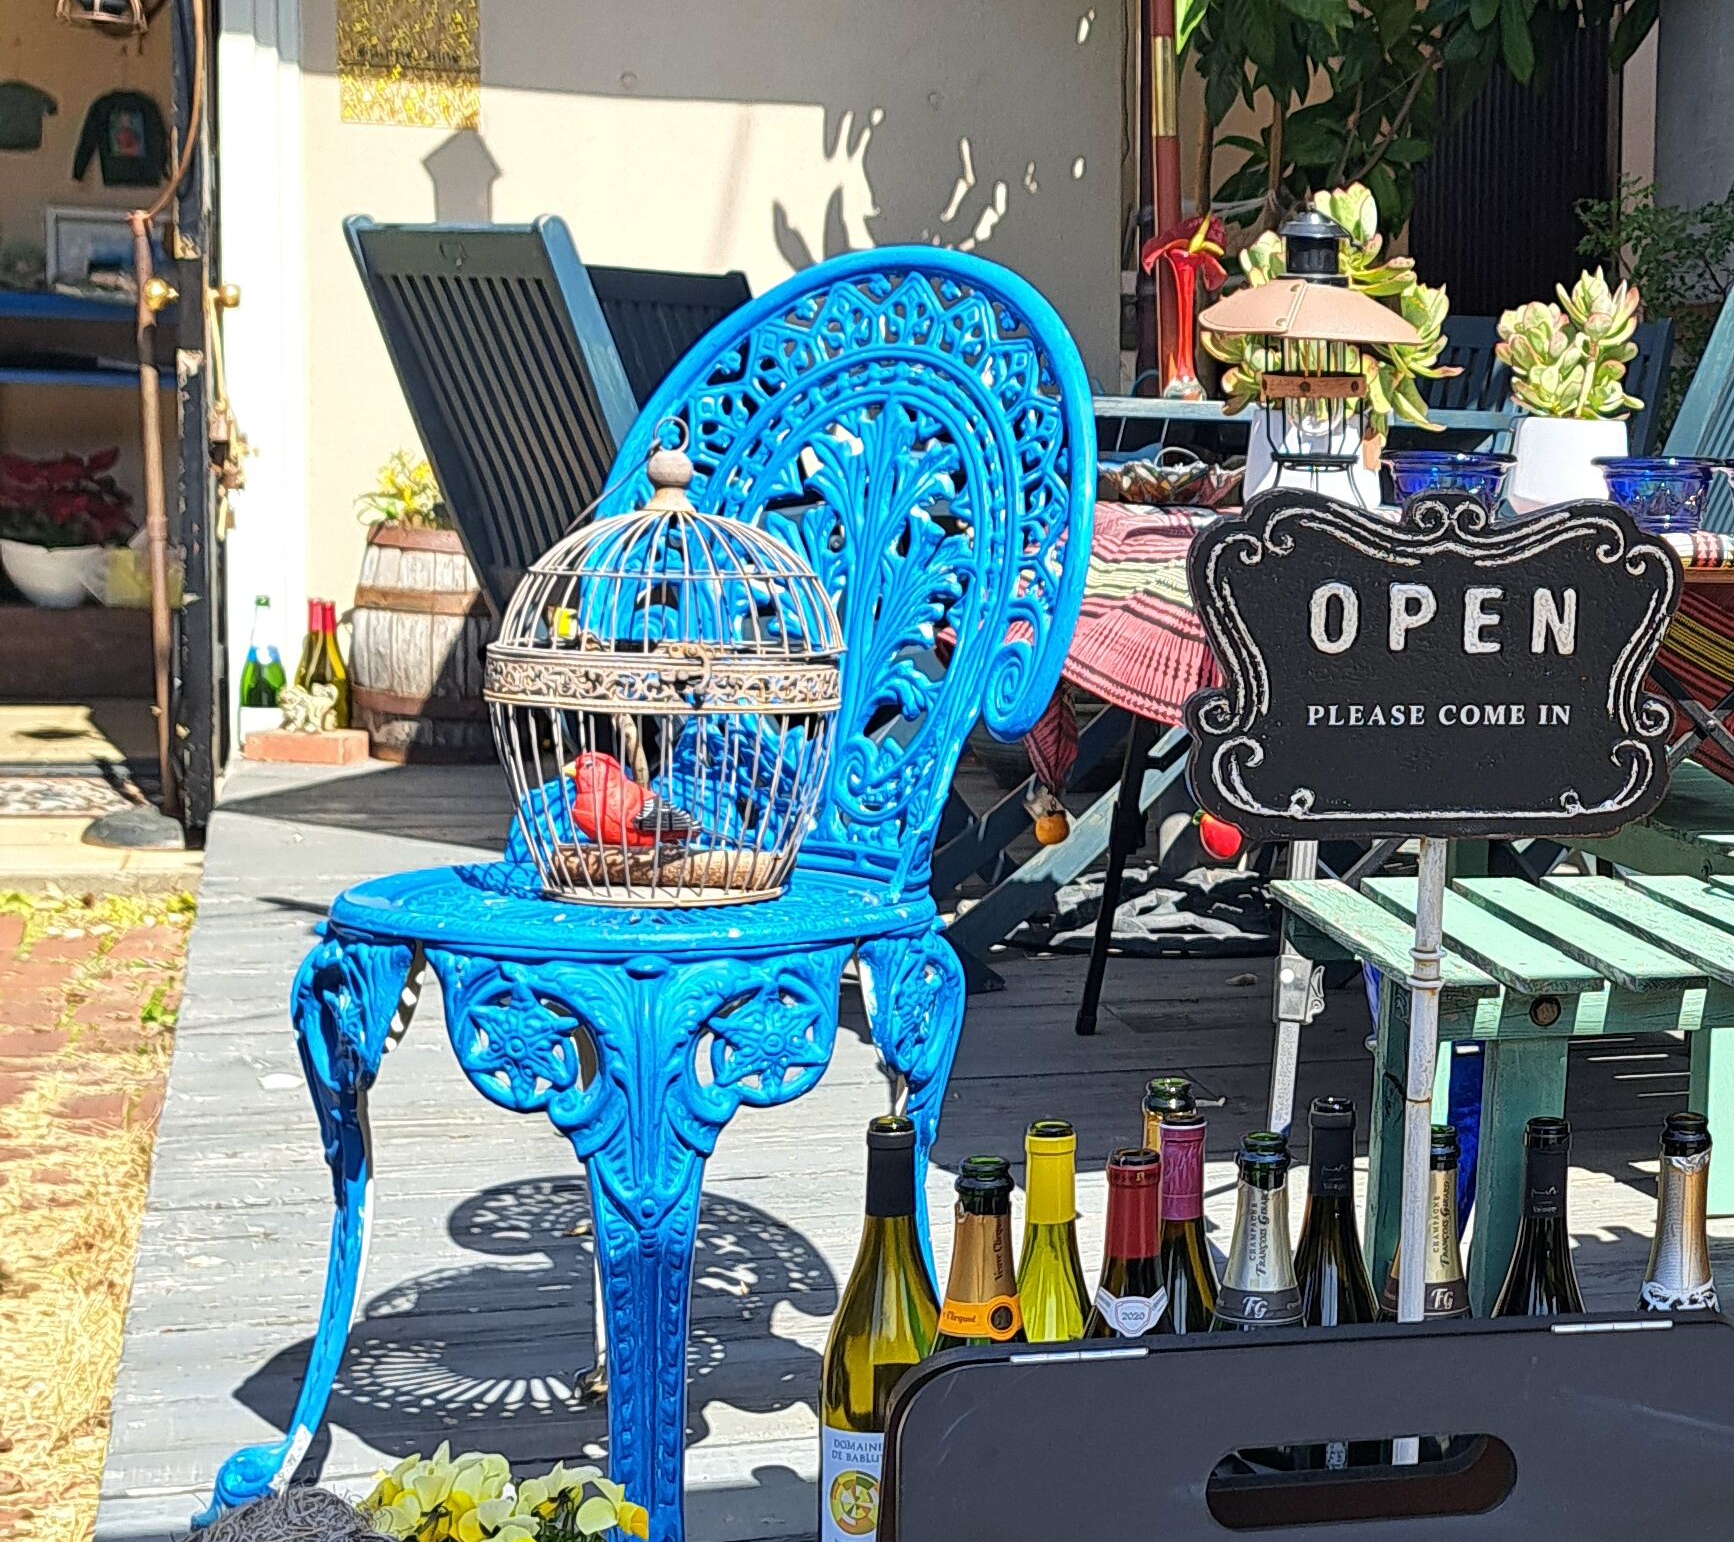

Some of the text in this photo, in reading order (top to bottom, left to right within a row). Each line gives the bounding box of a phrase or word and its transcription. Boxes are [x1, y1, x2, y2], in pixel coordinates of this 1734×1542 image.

[1308, 581, 1578, 655] OPEN
[1306, 704, 1570, 727] PLEASE COME IN
[1249, 1202, 1259, 1262] CHAMPAGNE
[1432, 1195, 1441, 1254] CHAMPAGNE
[1120, 1310, 1145, 1322] 2020
[1242, 1295, 1270, 1320] FG
